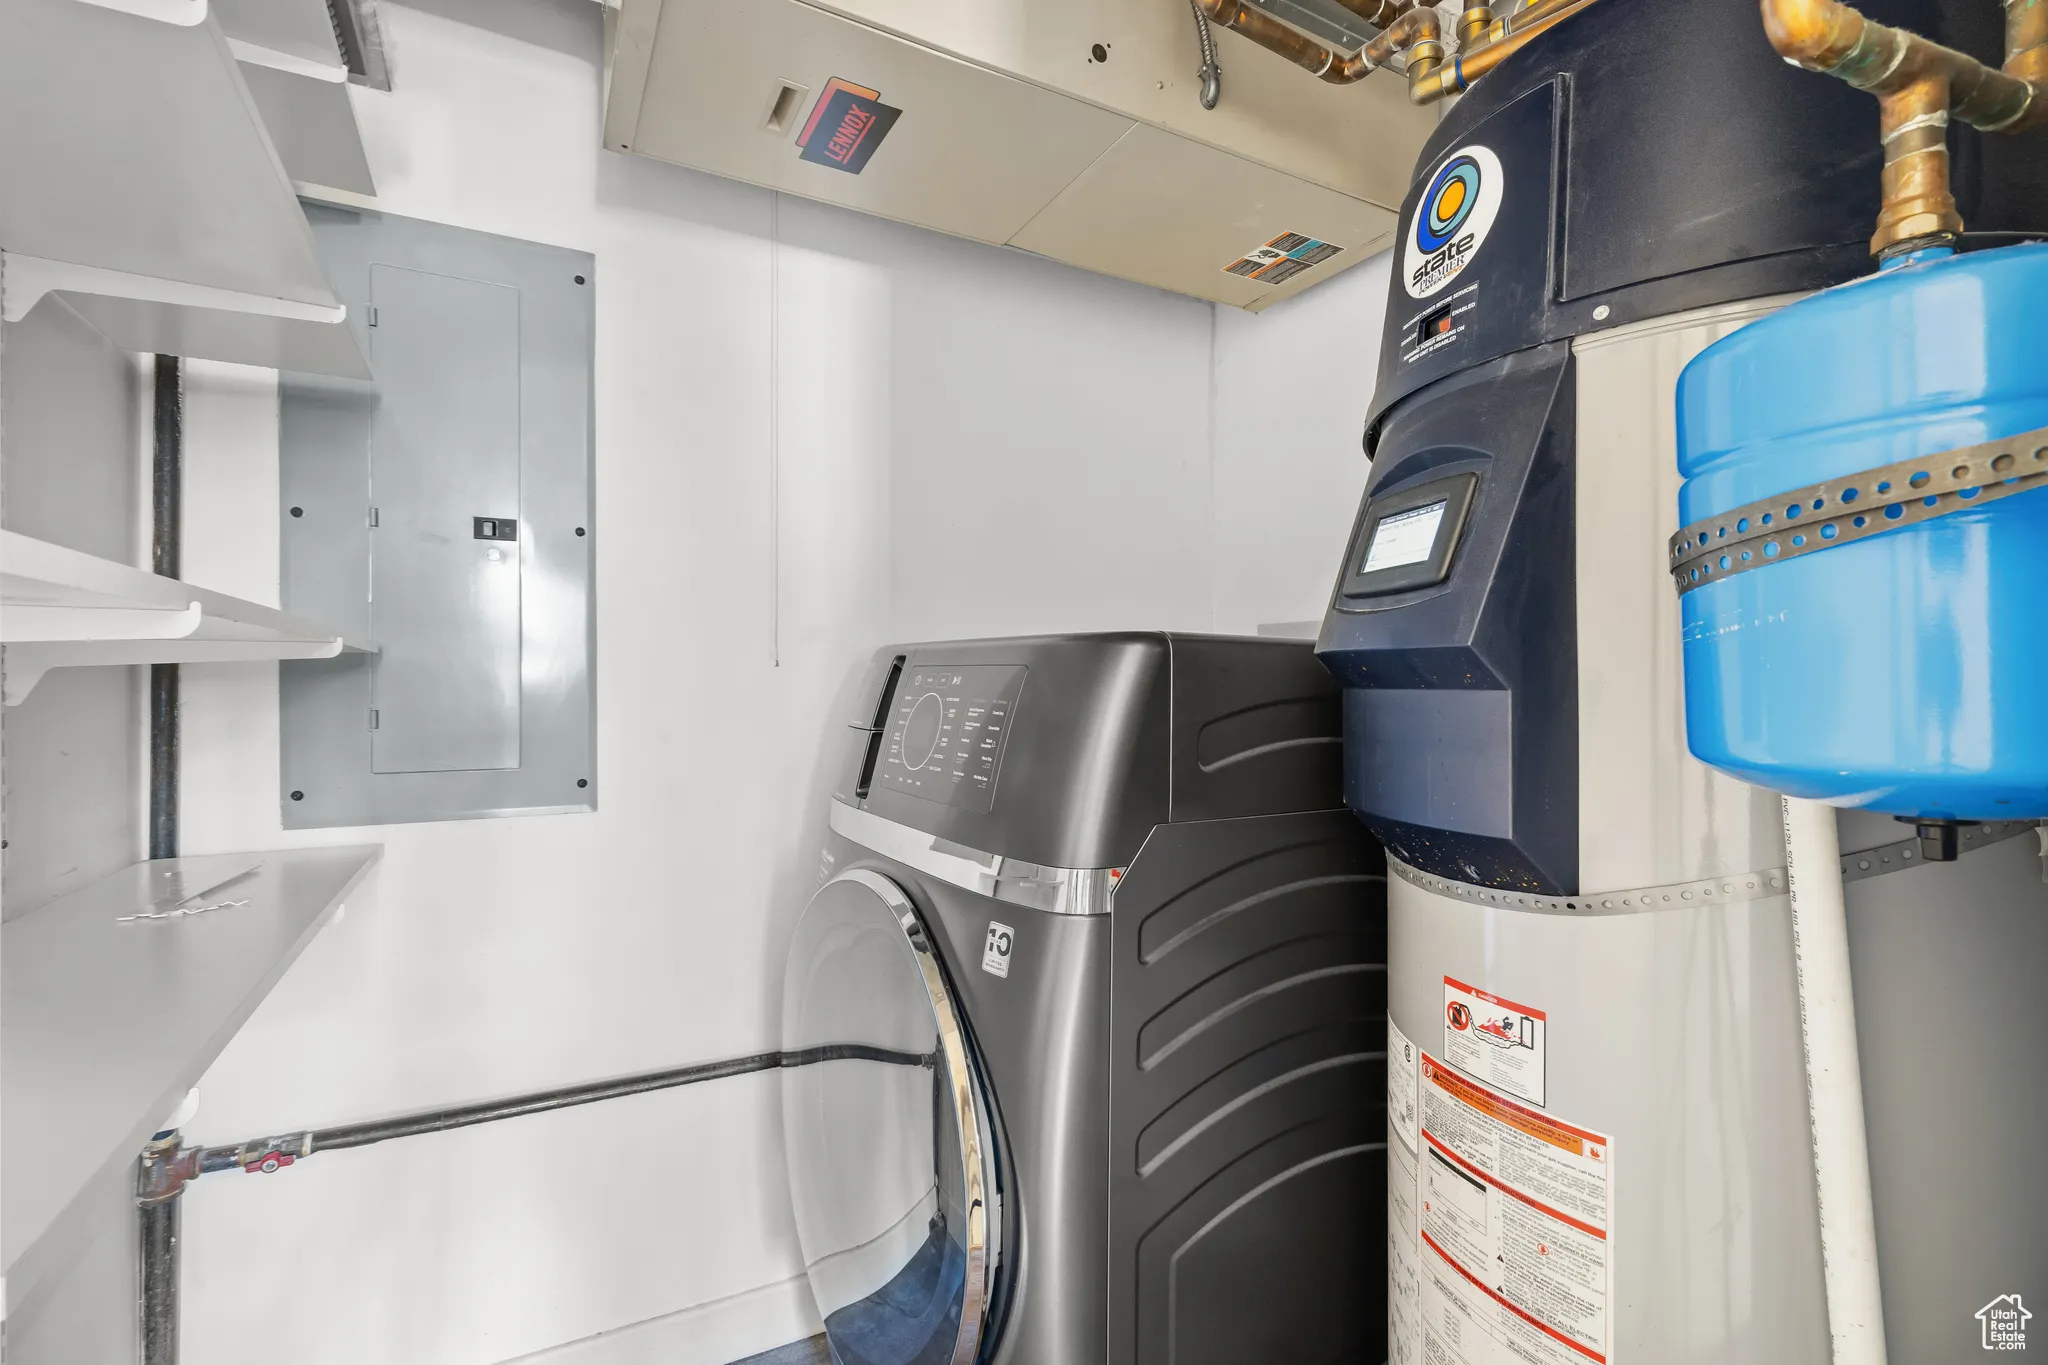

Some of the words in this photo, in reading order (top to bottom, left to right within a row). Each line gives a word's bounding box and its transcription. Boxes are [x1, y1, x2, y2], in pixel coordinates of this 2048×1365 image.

[824, 104, 870, 162] LENNOX
[1412, 232, 1474, 288] state
[1420, 254, 1465, 290] PREMIER
[1443, 264, 1464, 280] VENT
[1452, 302, 1475, 316] ENABLED
[1782, 798, 1792, 844] PVC-1120
[989, 928, 1011, 956] 10
[985, 962, 1004, 972] WARRANTY
[988, 958, 1002, 966] LIMITED
[1478, 992, 1498, 1004] DANGER
[1444, 1069, 1453, 1079] FOR
[1453, 1074, 1465, 1086] YOUR
[1465, 1081, 1484, 1096] SAFETY
[1486, 1091, 1501, 1103] READ
[1501, 1098, 1526, 1115] BEFORE
[1526, 1110, 1557, 1127] LIGHTING
[1508, 1110, 1536, 1127] instructions
[1561, 1132, 1570, 1141] fire
[1530, 1125, 1552, 1139] personal
[1553, 1134, 1568, 1145] injury
[1505, 1130, 1517, 1140] FROM
[1518, 1136, 1526, 1144] ALL
[1527, 1140, 1540, 1150] LINES
[1532, 1137, 1548, 1148] FILLED
[1548, 1155, 1556, 1163] gas
[1578, 1167, 1587, 1176] call
[1587, 1171, 1595, 1179] the
[1596, 1174, 1605, 1183] fire
[1488, 1176, 1535, 1206] INSTRUCTIONS
[1559, 1242, 1579, 1257] BURNER
[1589, 1256, 1604, 1268] HAND
[1456, 1263, 1470, 1280] TURN
[1471, 1275, 1481, 1289] OFF
[1483, 1284, 1496, 1299] GAS
[1497, 1295, 1506, 1307] TO
[1508, 1302, 1544, 1331] APPLIANCE
[1550, 1286, 1574, 1304] changing
[1531, 1303, 1544, 1315] TURN
[1545, 1312, 1555, 1322] OFF
[1557, 1318, 1568, 1329] ALL
[1568, 1324, 1598, 1344] ELECTRIC
